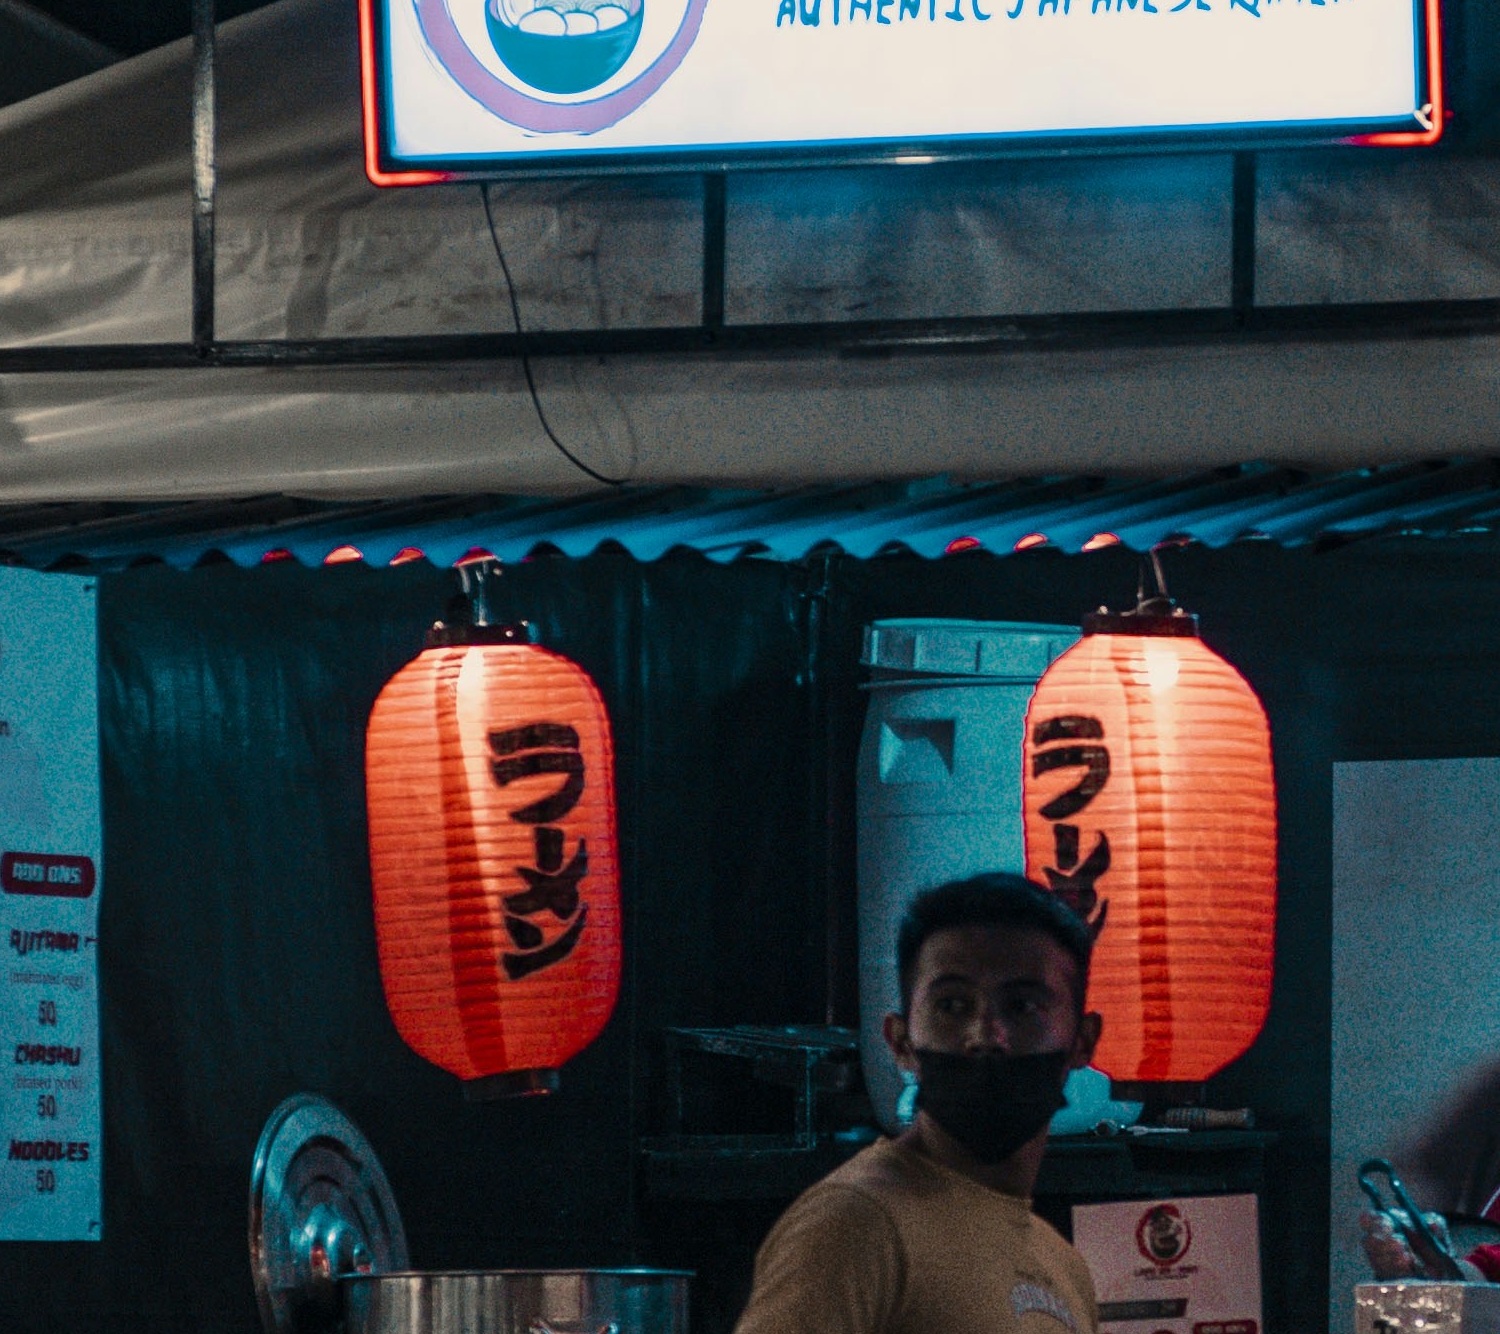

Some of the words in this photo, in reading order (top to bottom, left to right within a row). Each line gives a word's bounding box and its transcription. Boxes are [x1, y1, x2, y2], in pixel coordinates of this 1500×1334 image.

[486, 721, 590, 983] ラーメン
[38, 1000, 57, 1026] 50
[15, 1043, 82, 1066] CHASHU
[37, 1094, 56, 1119] 50
[8, 1138, 90, 1162] NOODLES
[36, 1169, 56, 1194] 50
